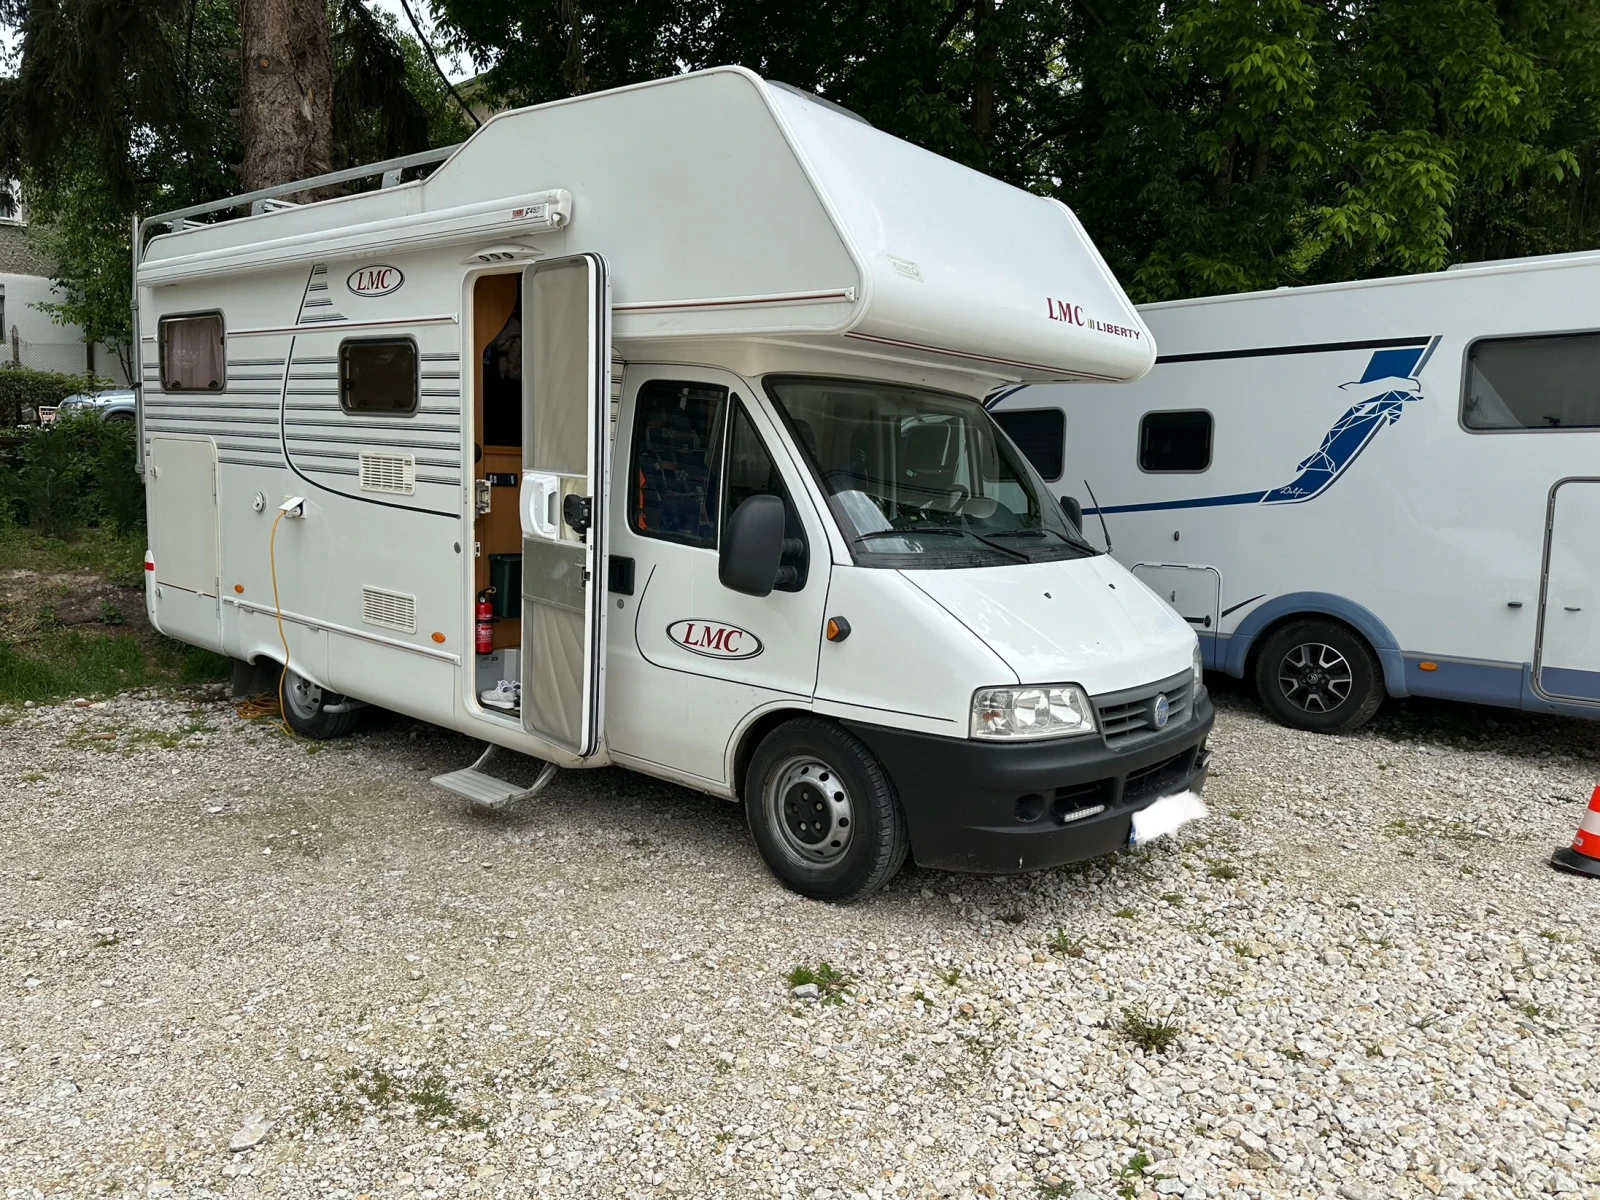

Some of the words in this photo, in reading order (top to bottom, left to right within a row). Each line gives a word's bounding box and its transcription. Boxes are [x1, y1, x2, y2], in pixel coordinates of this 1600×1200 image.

[357, 268, 393, 290] LMC
[1046, 297, 1085, 326] LMC
[1097, 321, 1140, 339] LIBERTY
[683, 622, 743, 652] LMC
